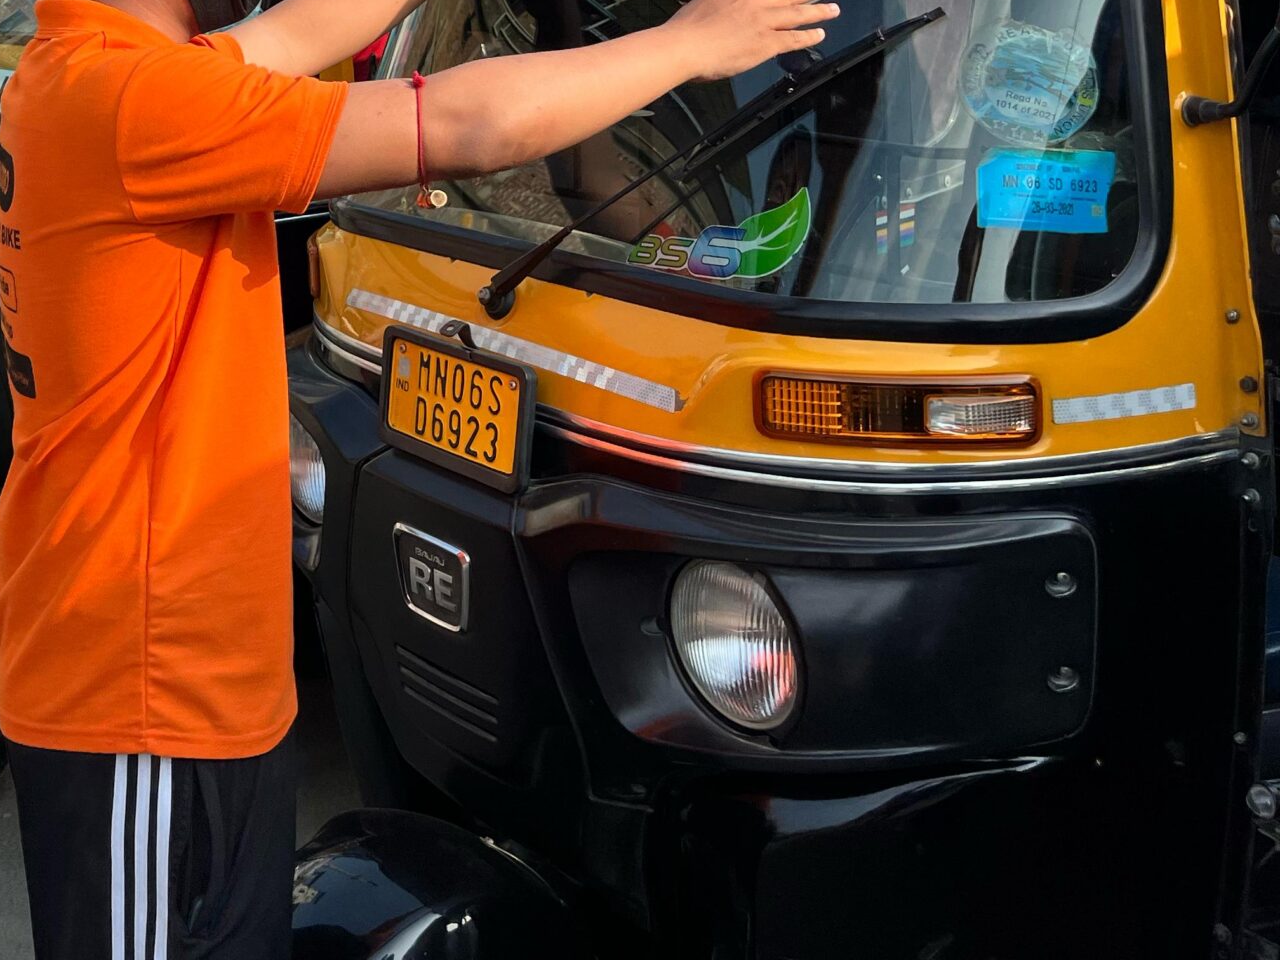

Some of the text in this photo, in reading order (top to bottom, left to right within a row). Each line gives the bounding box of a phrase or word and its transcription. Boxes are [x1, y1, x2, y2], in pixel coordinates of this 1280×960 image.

[995, 99, 1056, 120] 1014 of 2021
[1005, 91, 1031, 104] Regd
[1002, 175, 1098, 193] MN 06 SD 6923
[1, 224, 21, 251] BIKE
[628, 224, 748, 279] BS6
[395, 377, 410, 393] IND
[417, 350, 504, 416] MN06S
[415, 396, 499, 463] D6923
[414, 546, 445, 567] BAJAJ
[409, 556, 457, 613] RE
